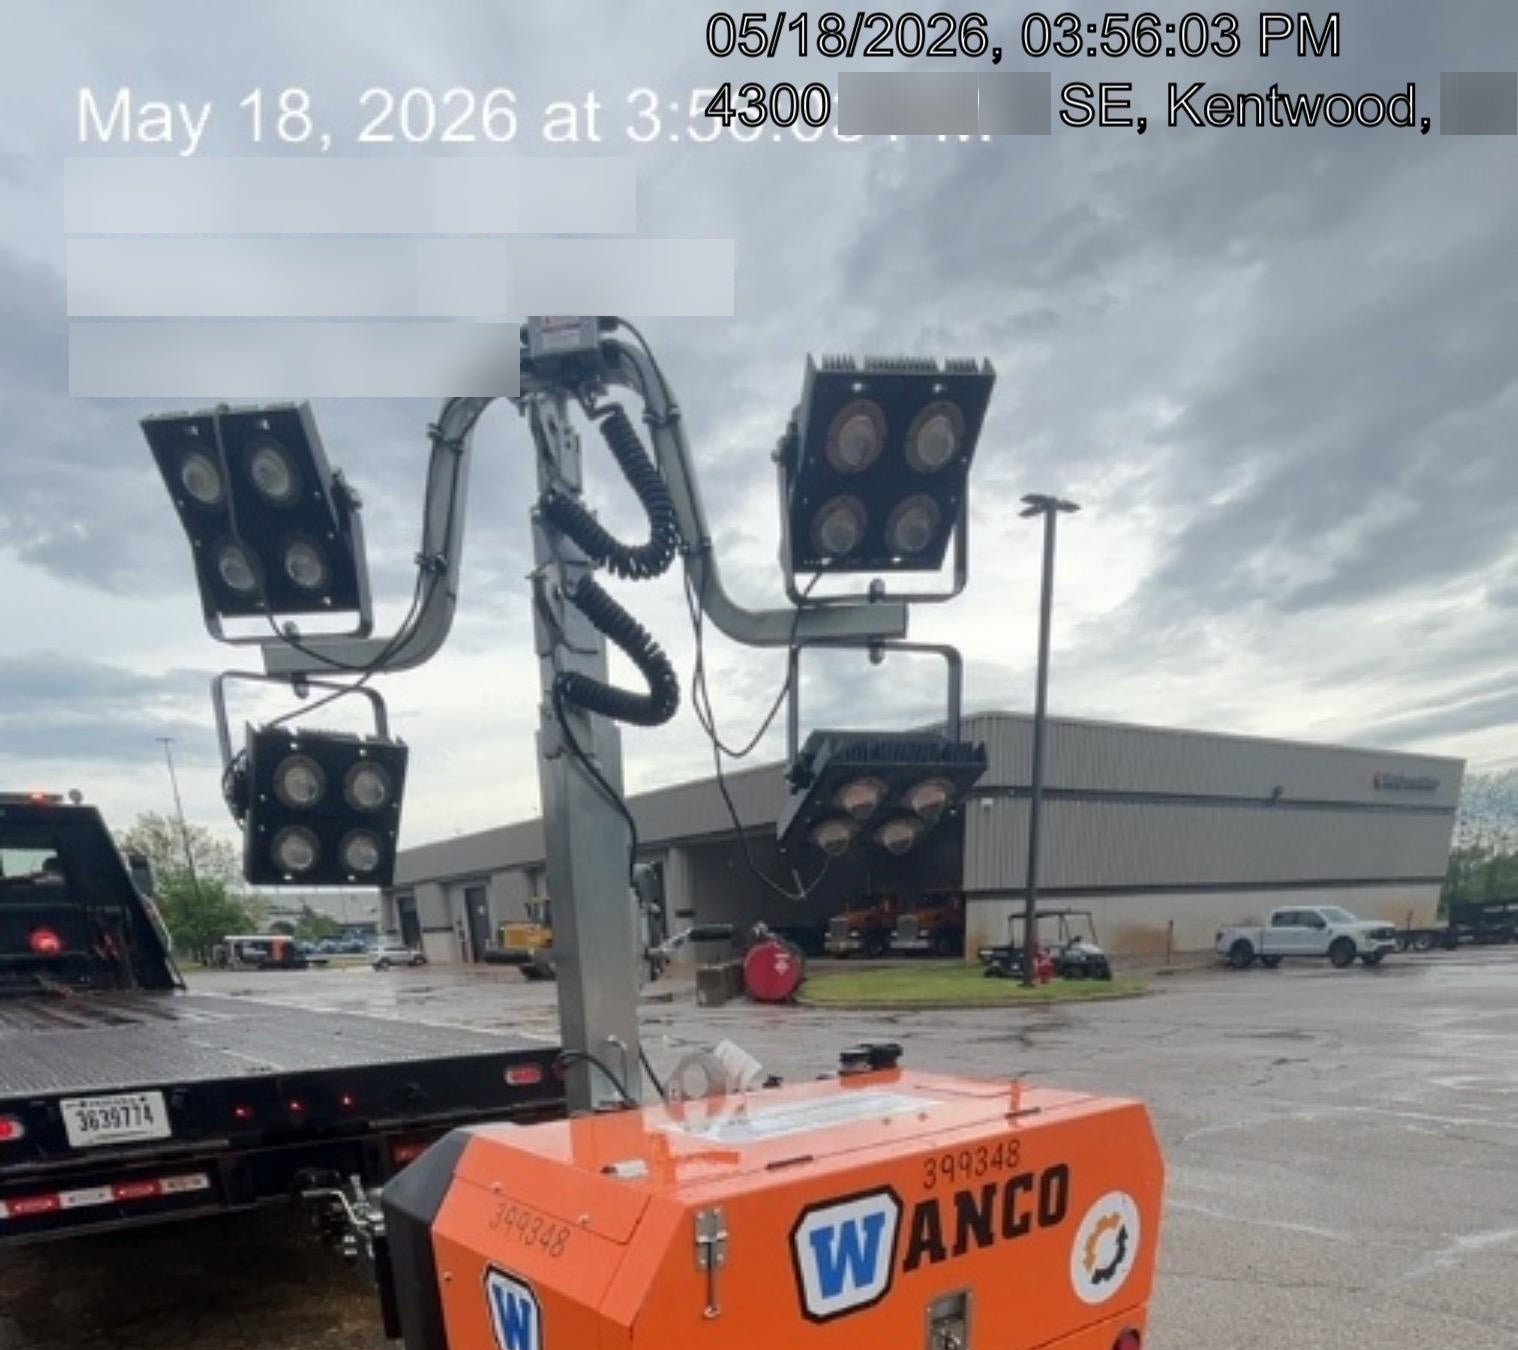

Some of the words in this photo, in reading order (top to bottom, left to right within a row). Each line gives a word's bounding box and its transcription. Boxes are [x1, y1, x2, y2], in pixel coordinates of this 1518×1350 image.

[923, 1139, 1021, 1190] 399348
[488, 1203, 571, 1258] 399348
[808, 1162, 1070, 1300] WANCO
